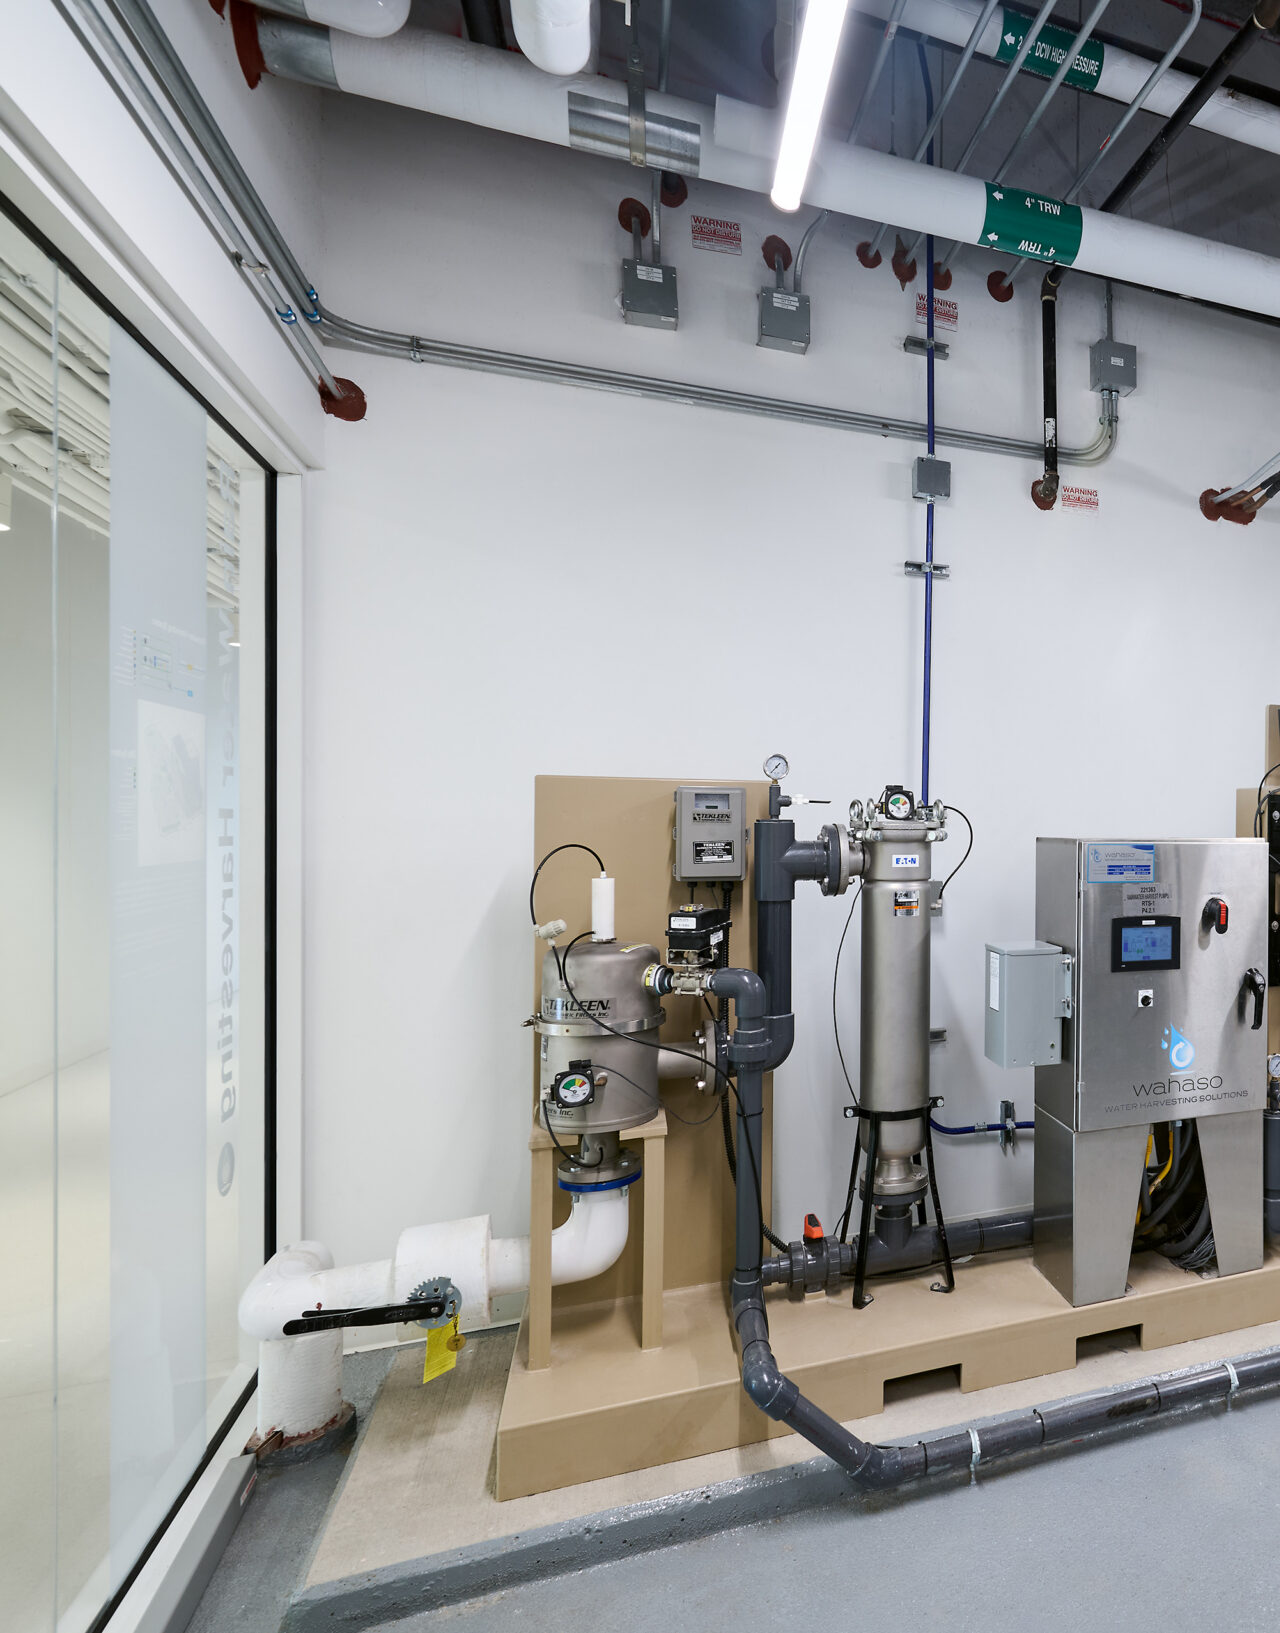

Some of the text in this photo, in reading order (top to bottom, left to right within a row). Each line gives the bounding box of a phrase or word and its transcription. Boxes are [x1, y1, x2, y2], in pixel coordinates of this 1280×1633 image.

[1035, 41, 1052, 60] DCW
[1070, 55, 1100, 76] RESSURE
[1025, 197, 1061, 216] 4" TRW
[692, 215, 740, 231] WARNING
[1018, 240, 1056, 257] 4" TRW
[1062, 486, 1098, 497] WARNING
[1132, 1075, 1224, 1098] wahaso
[1104, 1089, 1250, 1114] WATER HARVESTING SOLUTIONS
